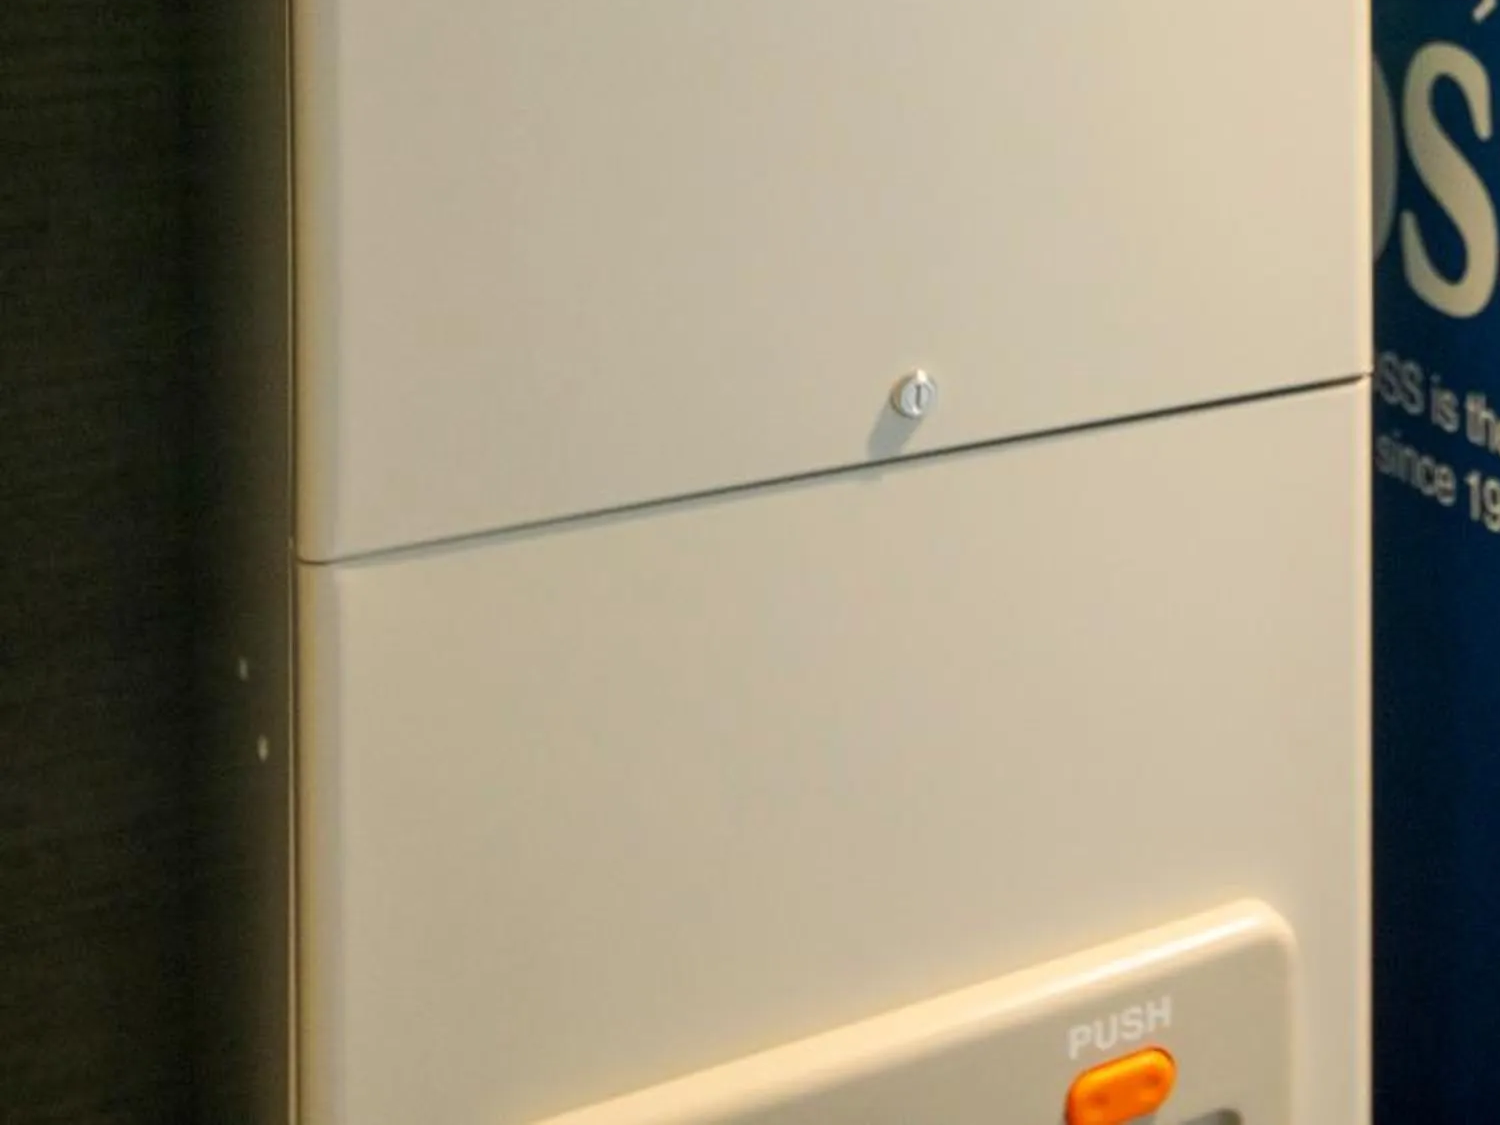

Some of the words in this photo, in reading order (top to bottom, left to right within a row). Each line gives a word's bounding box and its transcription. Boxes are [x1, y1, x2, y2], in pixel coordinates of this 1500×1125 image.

[1374, 351, 1424, 415] SS
[1431, 373, 1460, 433] is
[1376, 428, 1457, 506] since
[1067, 996, 1173, 1060] PUSH
